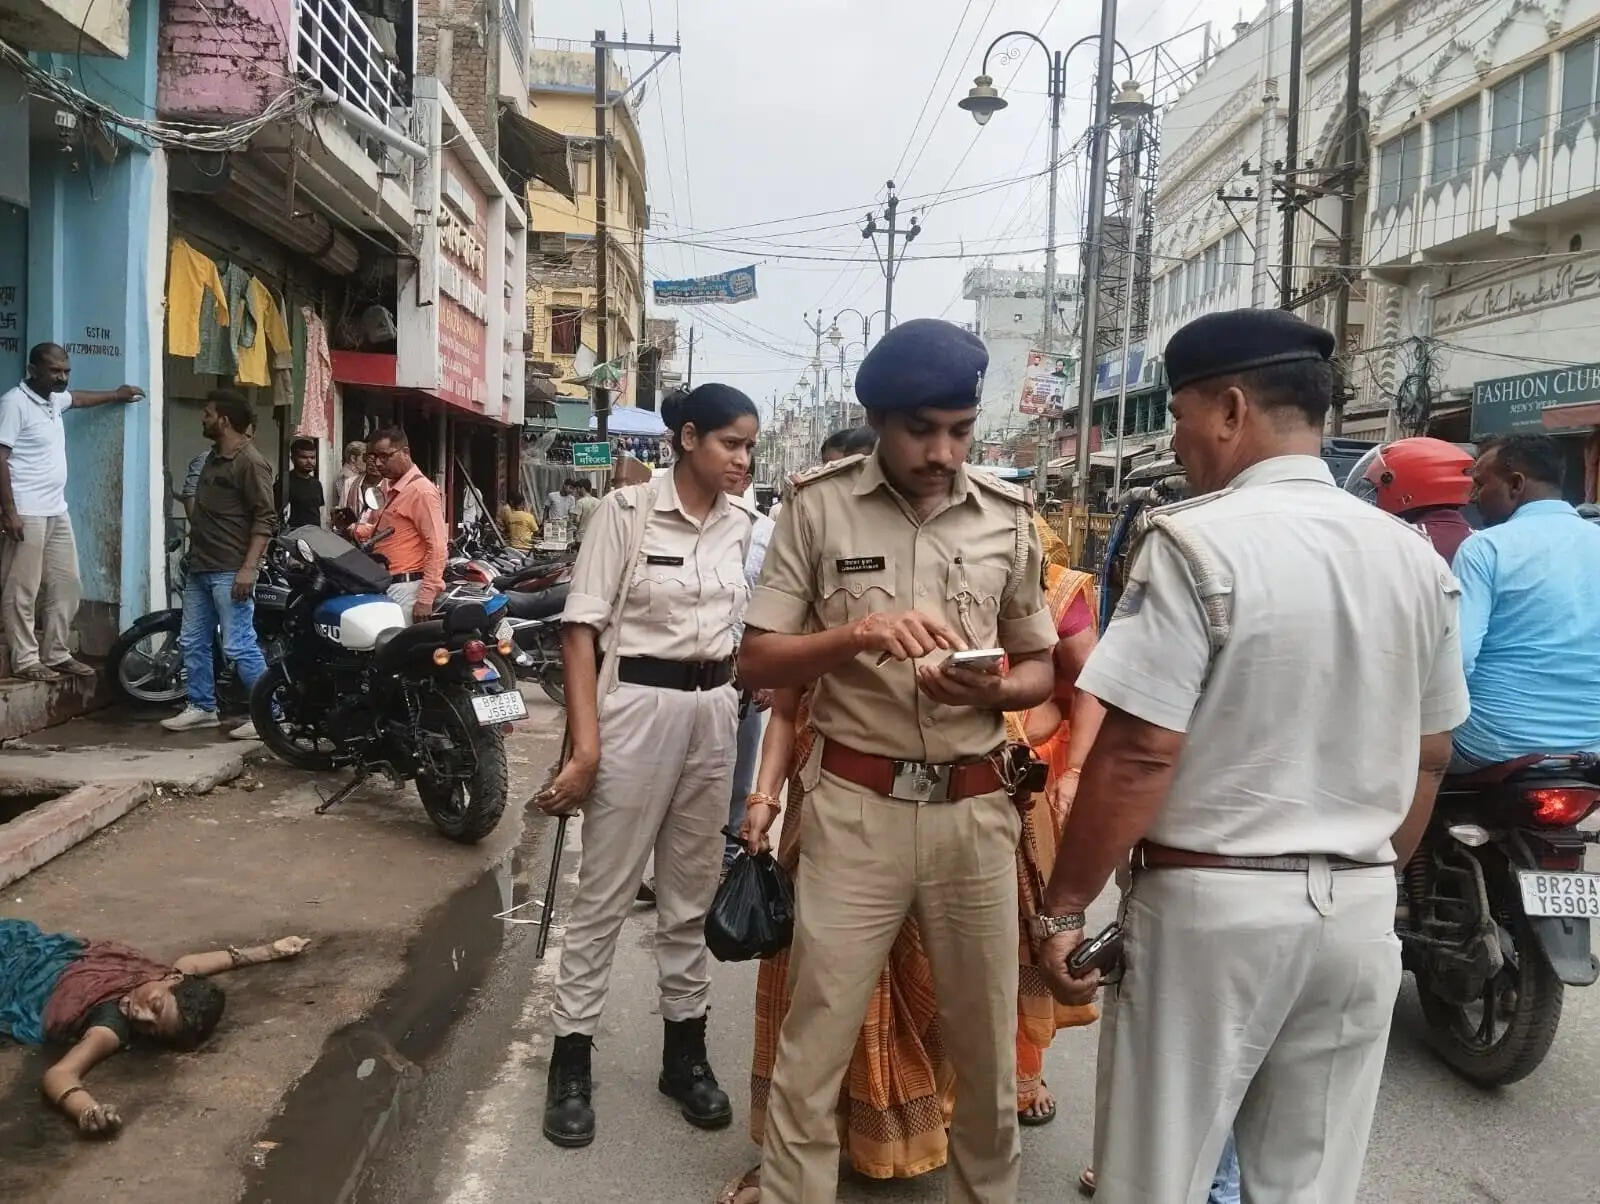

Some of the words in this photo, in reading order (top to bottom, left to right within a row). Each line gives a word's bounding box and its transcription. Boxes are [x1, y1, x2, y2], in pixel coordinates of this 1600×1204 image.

[1477, 375, 1548, 405] FASHION
[1553, 368, 1600, 394] CLUB
[1536, 876, 1597, 896] BR29A
[1538, 896, 1599, 915] Y5903
